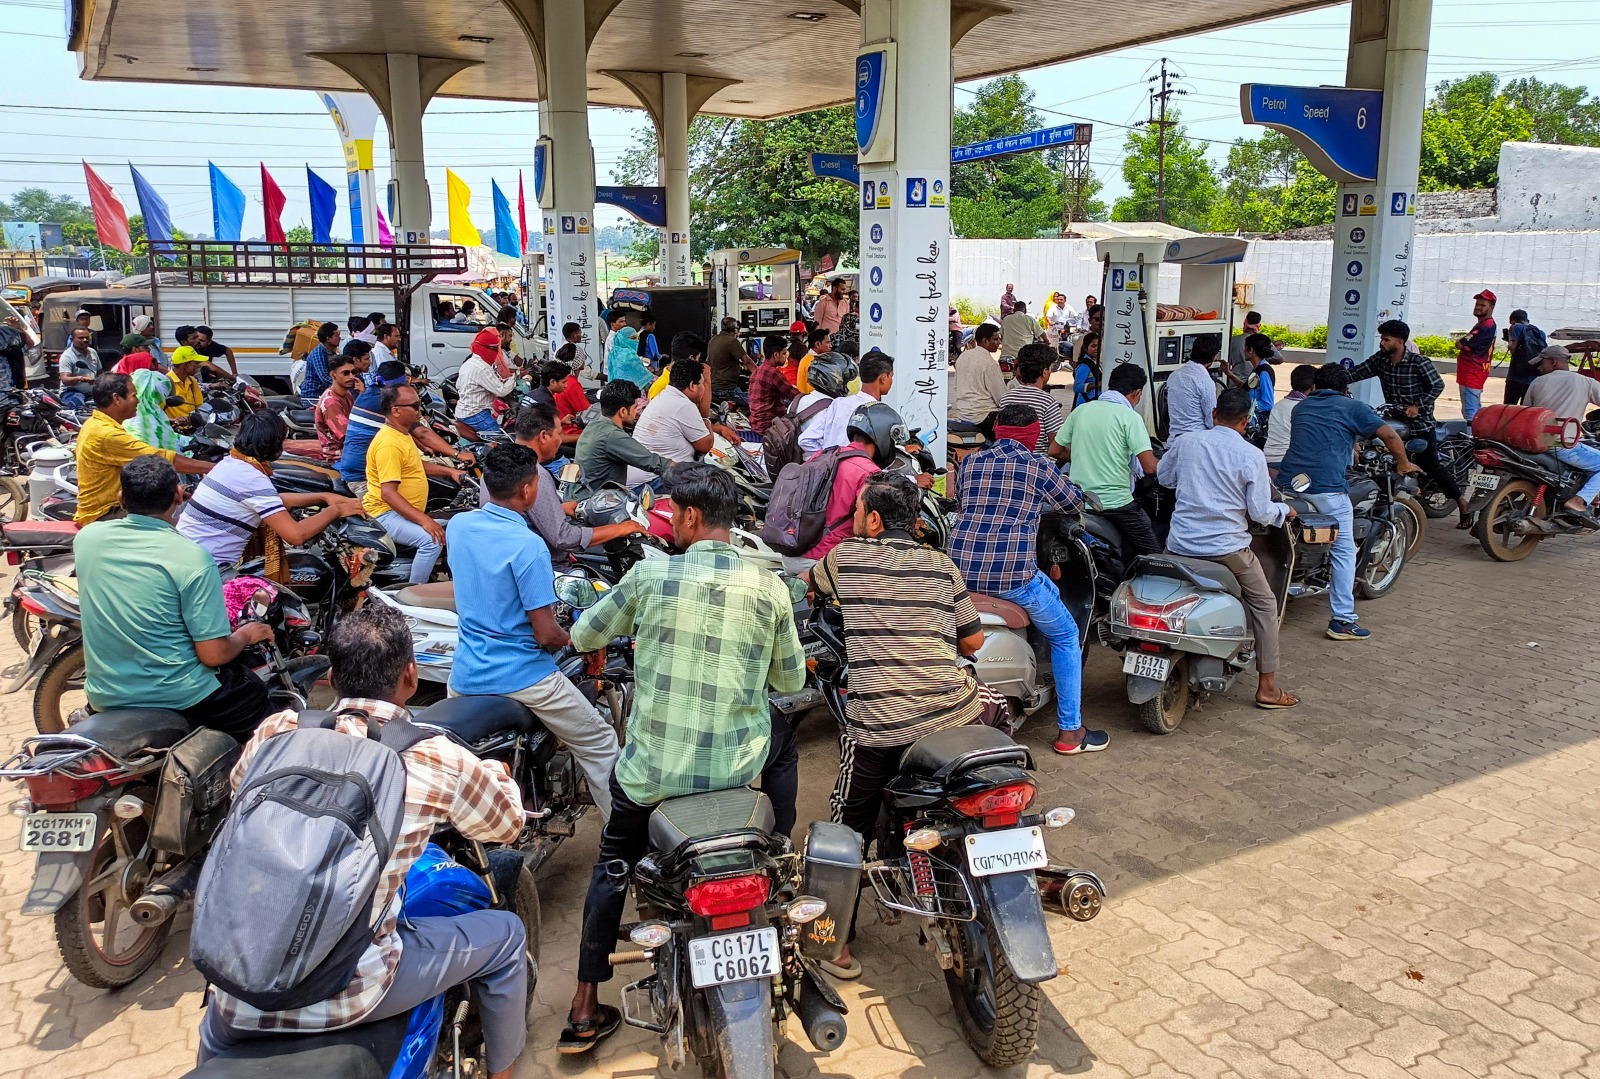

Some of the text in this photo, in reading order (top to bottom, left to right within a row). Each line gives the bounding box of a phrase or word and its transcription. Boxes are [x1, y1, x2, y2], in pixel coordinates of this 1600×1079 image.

[1262, 97, 1367, 130] Petrol Speed 6
[820, 160, 841, 169] Diesel
[598, 191, 658, 205] Diesel Petrol 2
[1395, 241, 1410, 260] kar
[571, 266, 590, 287] feel
[1393, 264, 1409, 288] feel
[573, 290, 589, 302] ko
[1391, 292, 1407, 308] ko
[1116, 296, 1135, 317] kar
[915, 240, 942, 396] Ab future ko feel kar
[1116, 321, 1137, 346] feel
[1133, 664, 1164, 680] D2025
[1136, 654, 1165, 670] CG17L
[32, 818, 83, 829] CG17KH
[25, 830, 86, 847] 2681
[290, 913, 311, 955] ONEGO
[711, 932, 769, 960] CG17L
[714, 954, 772, 982] C6062
